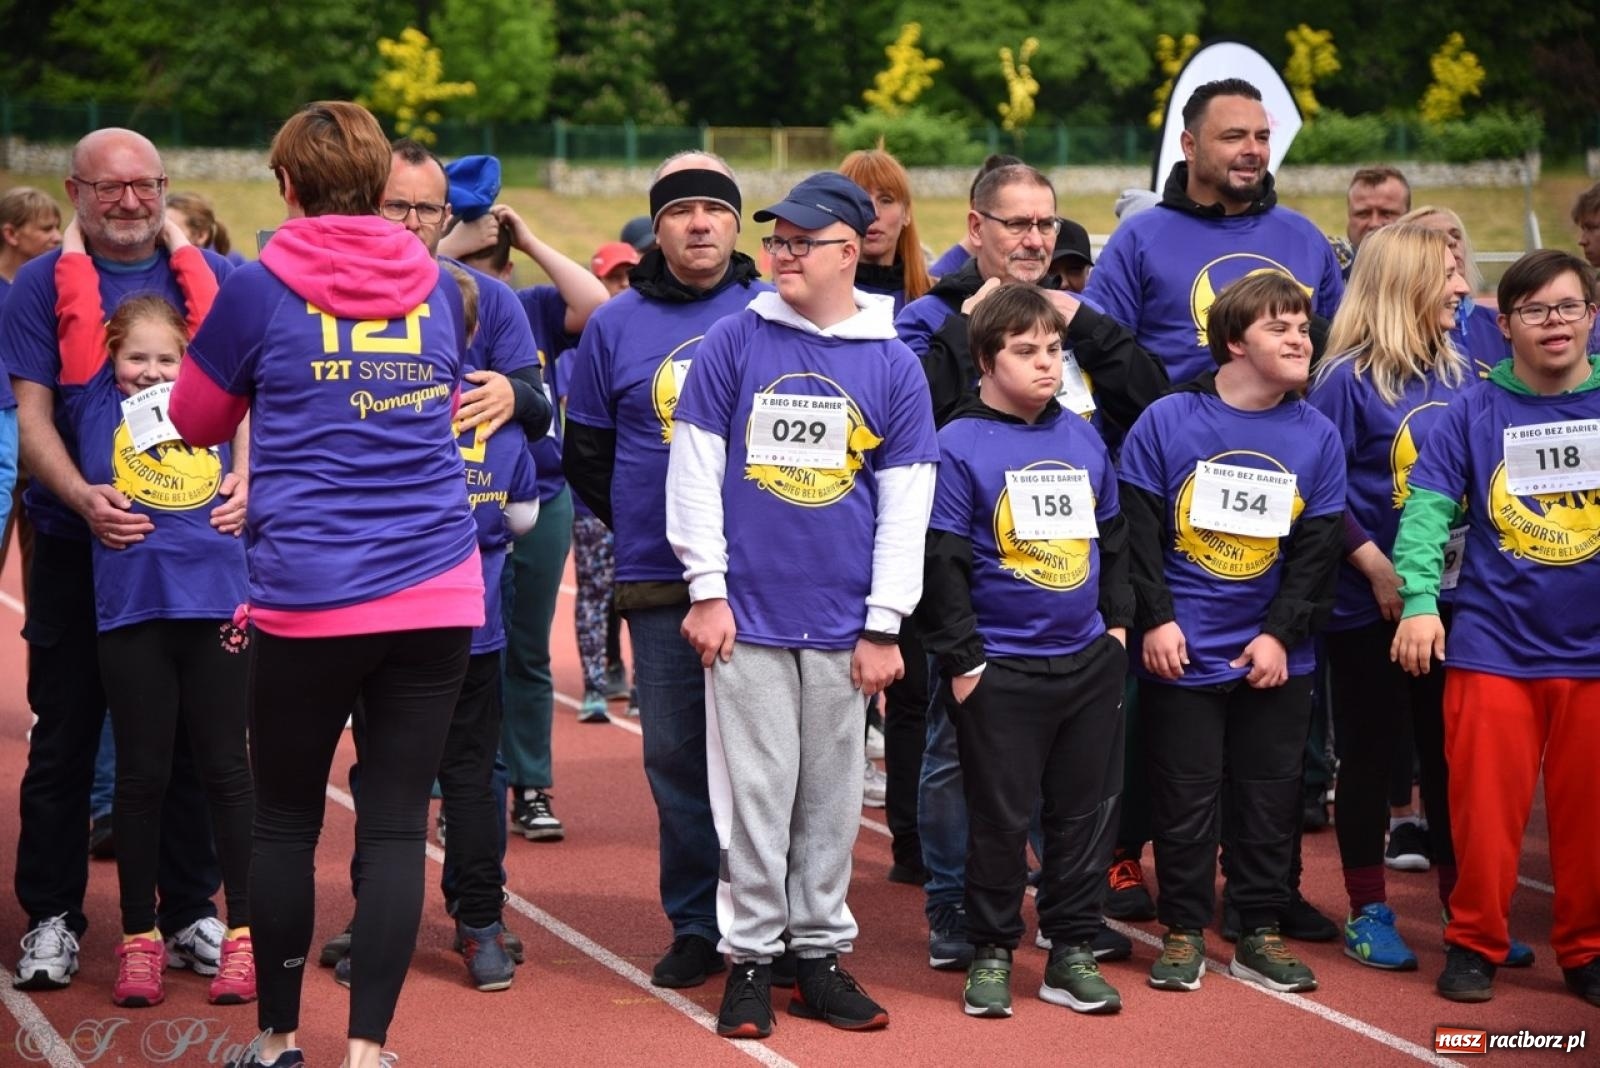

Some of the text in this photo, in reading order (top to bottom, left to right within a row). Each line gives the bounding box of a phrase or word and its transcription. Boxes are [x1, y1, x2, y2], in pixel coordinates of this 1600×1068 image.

[311, 360, 433, 381] T2T SYSTEM
[350, 383, 449, 419] Pomagamy
[770, 399, 790, 407] BIEG
[792, 400, 809, 408] BEZ
[812, 401, 842, 410] BARIER
[772, 418, 826, 444] 029
[1520, 429, 1542, 438] BIEG
[1545, 427, 1563, 435] BEZ
[1565, 424, 1598, 433] BARIER
[120, 446, 184, 490] RACIBORSKI
[1536, 446, 1581, 470] 118
[1020, 475, 1039, 483] BIEG
[1058, 474, 1082, 482] BARIER
[1213, 468, 1234, 478] BIEG
[1237, 472, 1254, 480] BEZ
[1257, 474, 1289, 485] BARIER
[783, 481, 841, 498] BIEG BEZ BARIER
[468, 491, 507, 510] gamy
[1032, 494, 1073, 517] 158
[1221, 489, 1267, 515] 154
[1500, 504, 1569, 545] RACIBORSKI
[1005, 528, 1068, 571] RACIBORSKI
[1538, 545, 1556, 557] BIEG
[1558, 546, 1574, 557] BEZ
[1229, 563, 1243, 572] BEZ
